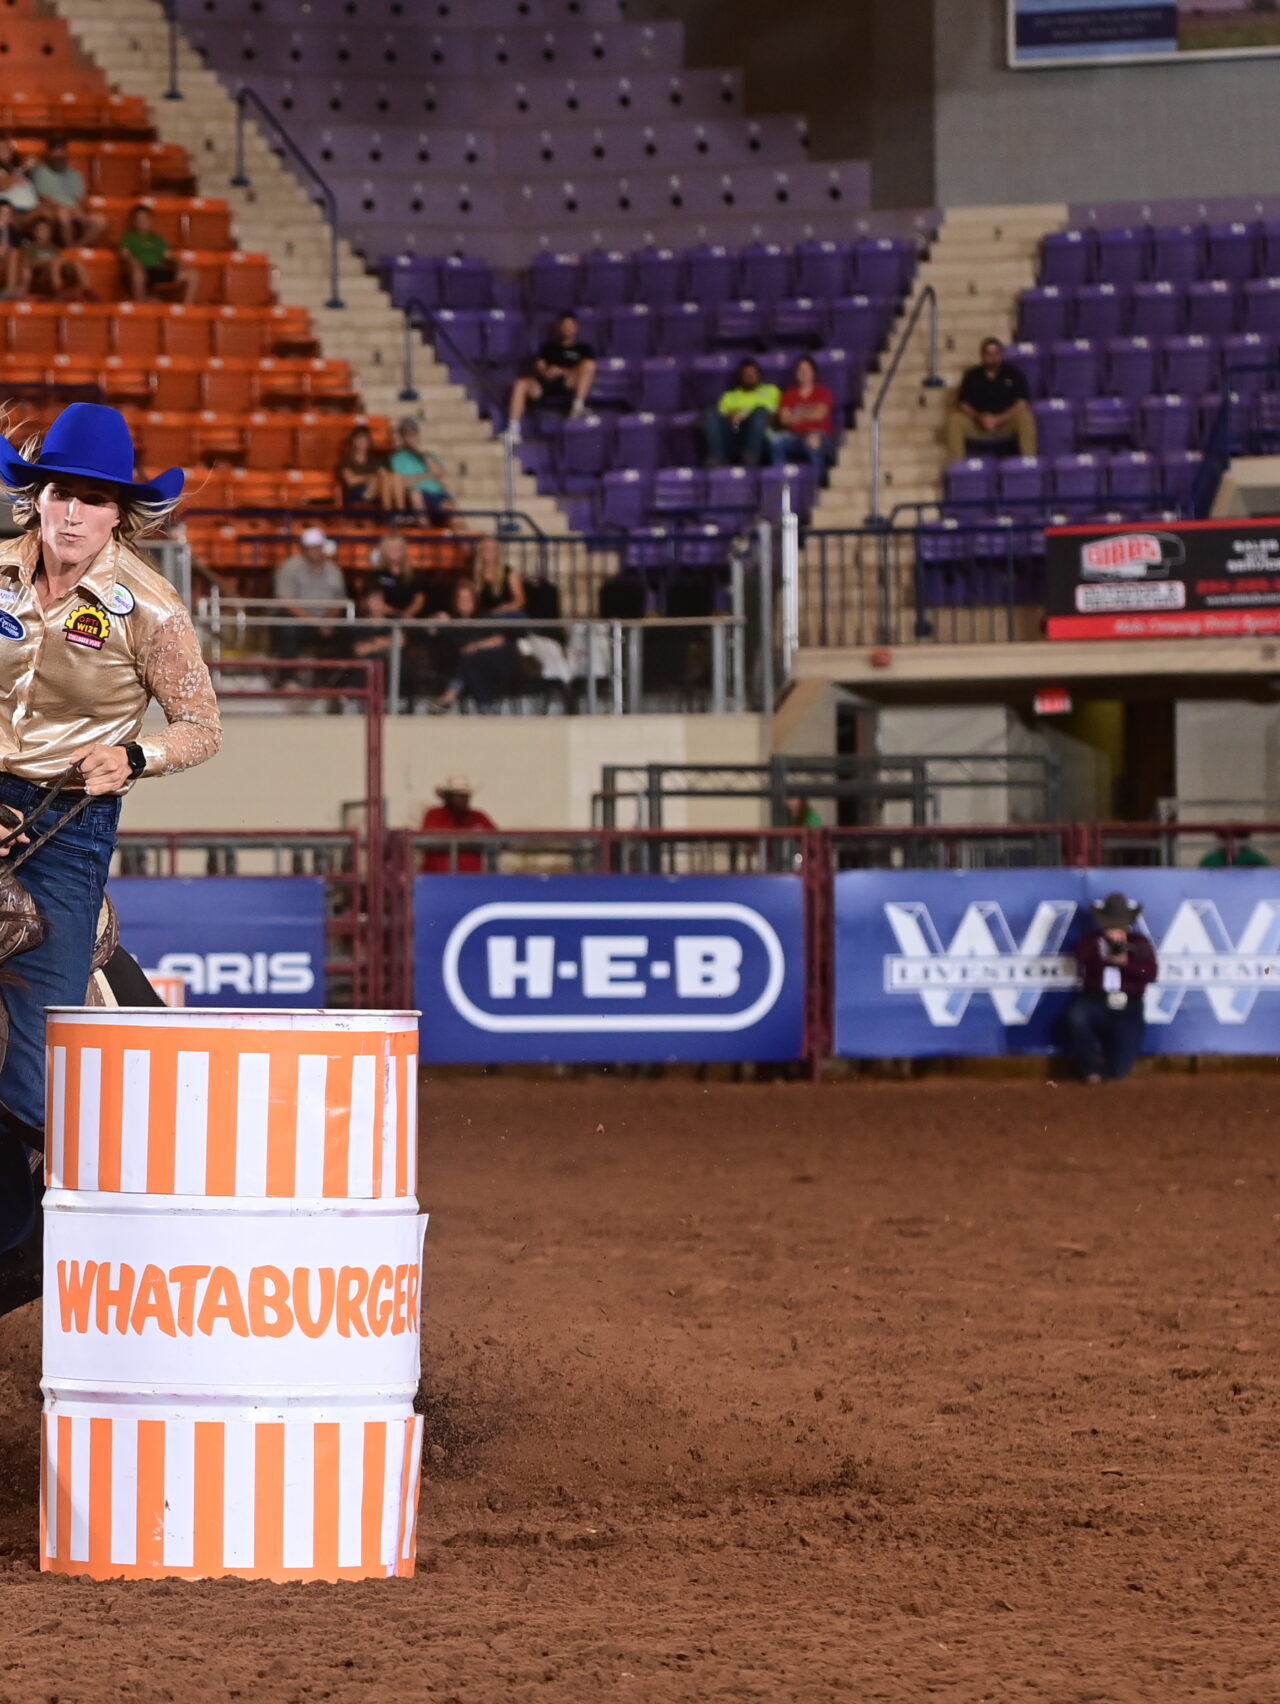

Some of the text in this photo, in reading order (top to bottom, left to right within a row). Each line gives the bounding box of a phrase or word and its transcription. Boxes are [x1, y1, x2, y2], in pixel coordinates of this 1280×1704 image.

[77, 622, 99, 635] WIZE
[79, 615, 99, 626] OPTI
[148, 952, 316, 995] ARIS
[897, 963, 1062, 980] LIVESTOC
[56, 1258, 420, 1339] WHATABURGER
